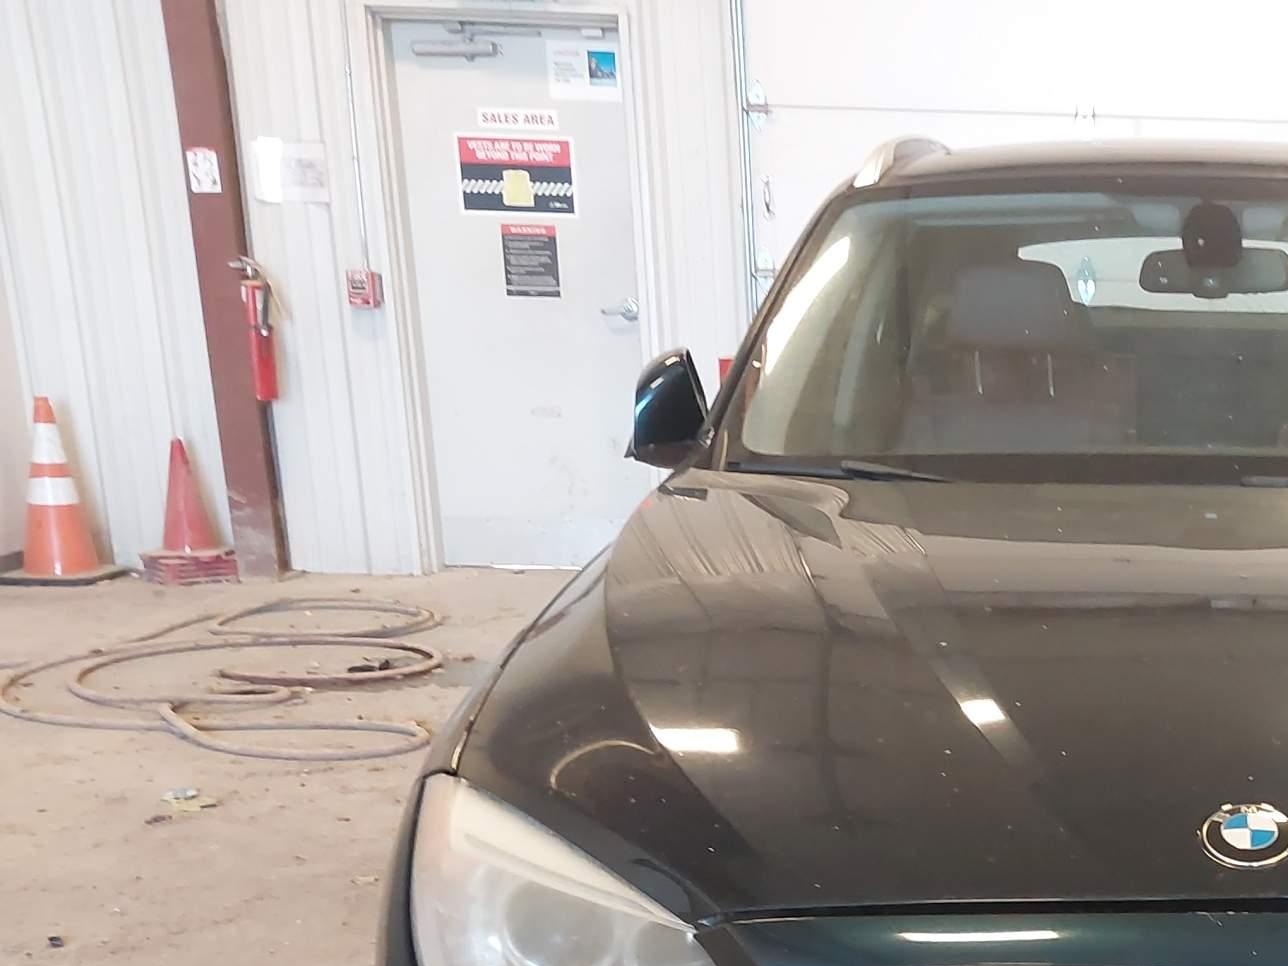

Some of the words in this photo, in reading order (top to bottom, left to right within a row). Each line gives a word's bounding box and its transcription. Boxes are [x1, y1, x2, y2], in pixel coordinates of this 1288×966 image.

[481, 111, 519, 125] SALES
[523, 113, 555, 126] AREA
[495, 140, 510, 151] ARE
[511, 141, 522, 152] TO
[522, 141, 534, 152] BE
[475, 150, 509, 160] BEYOND
[510, 151, 529, 161] THIS
[529, 152, 553, 162] POINT
